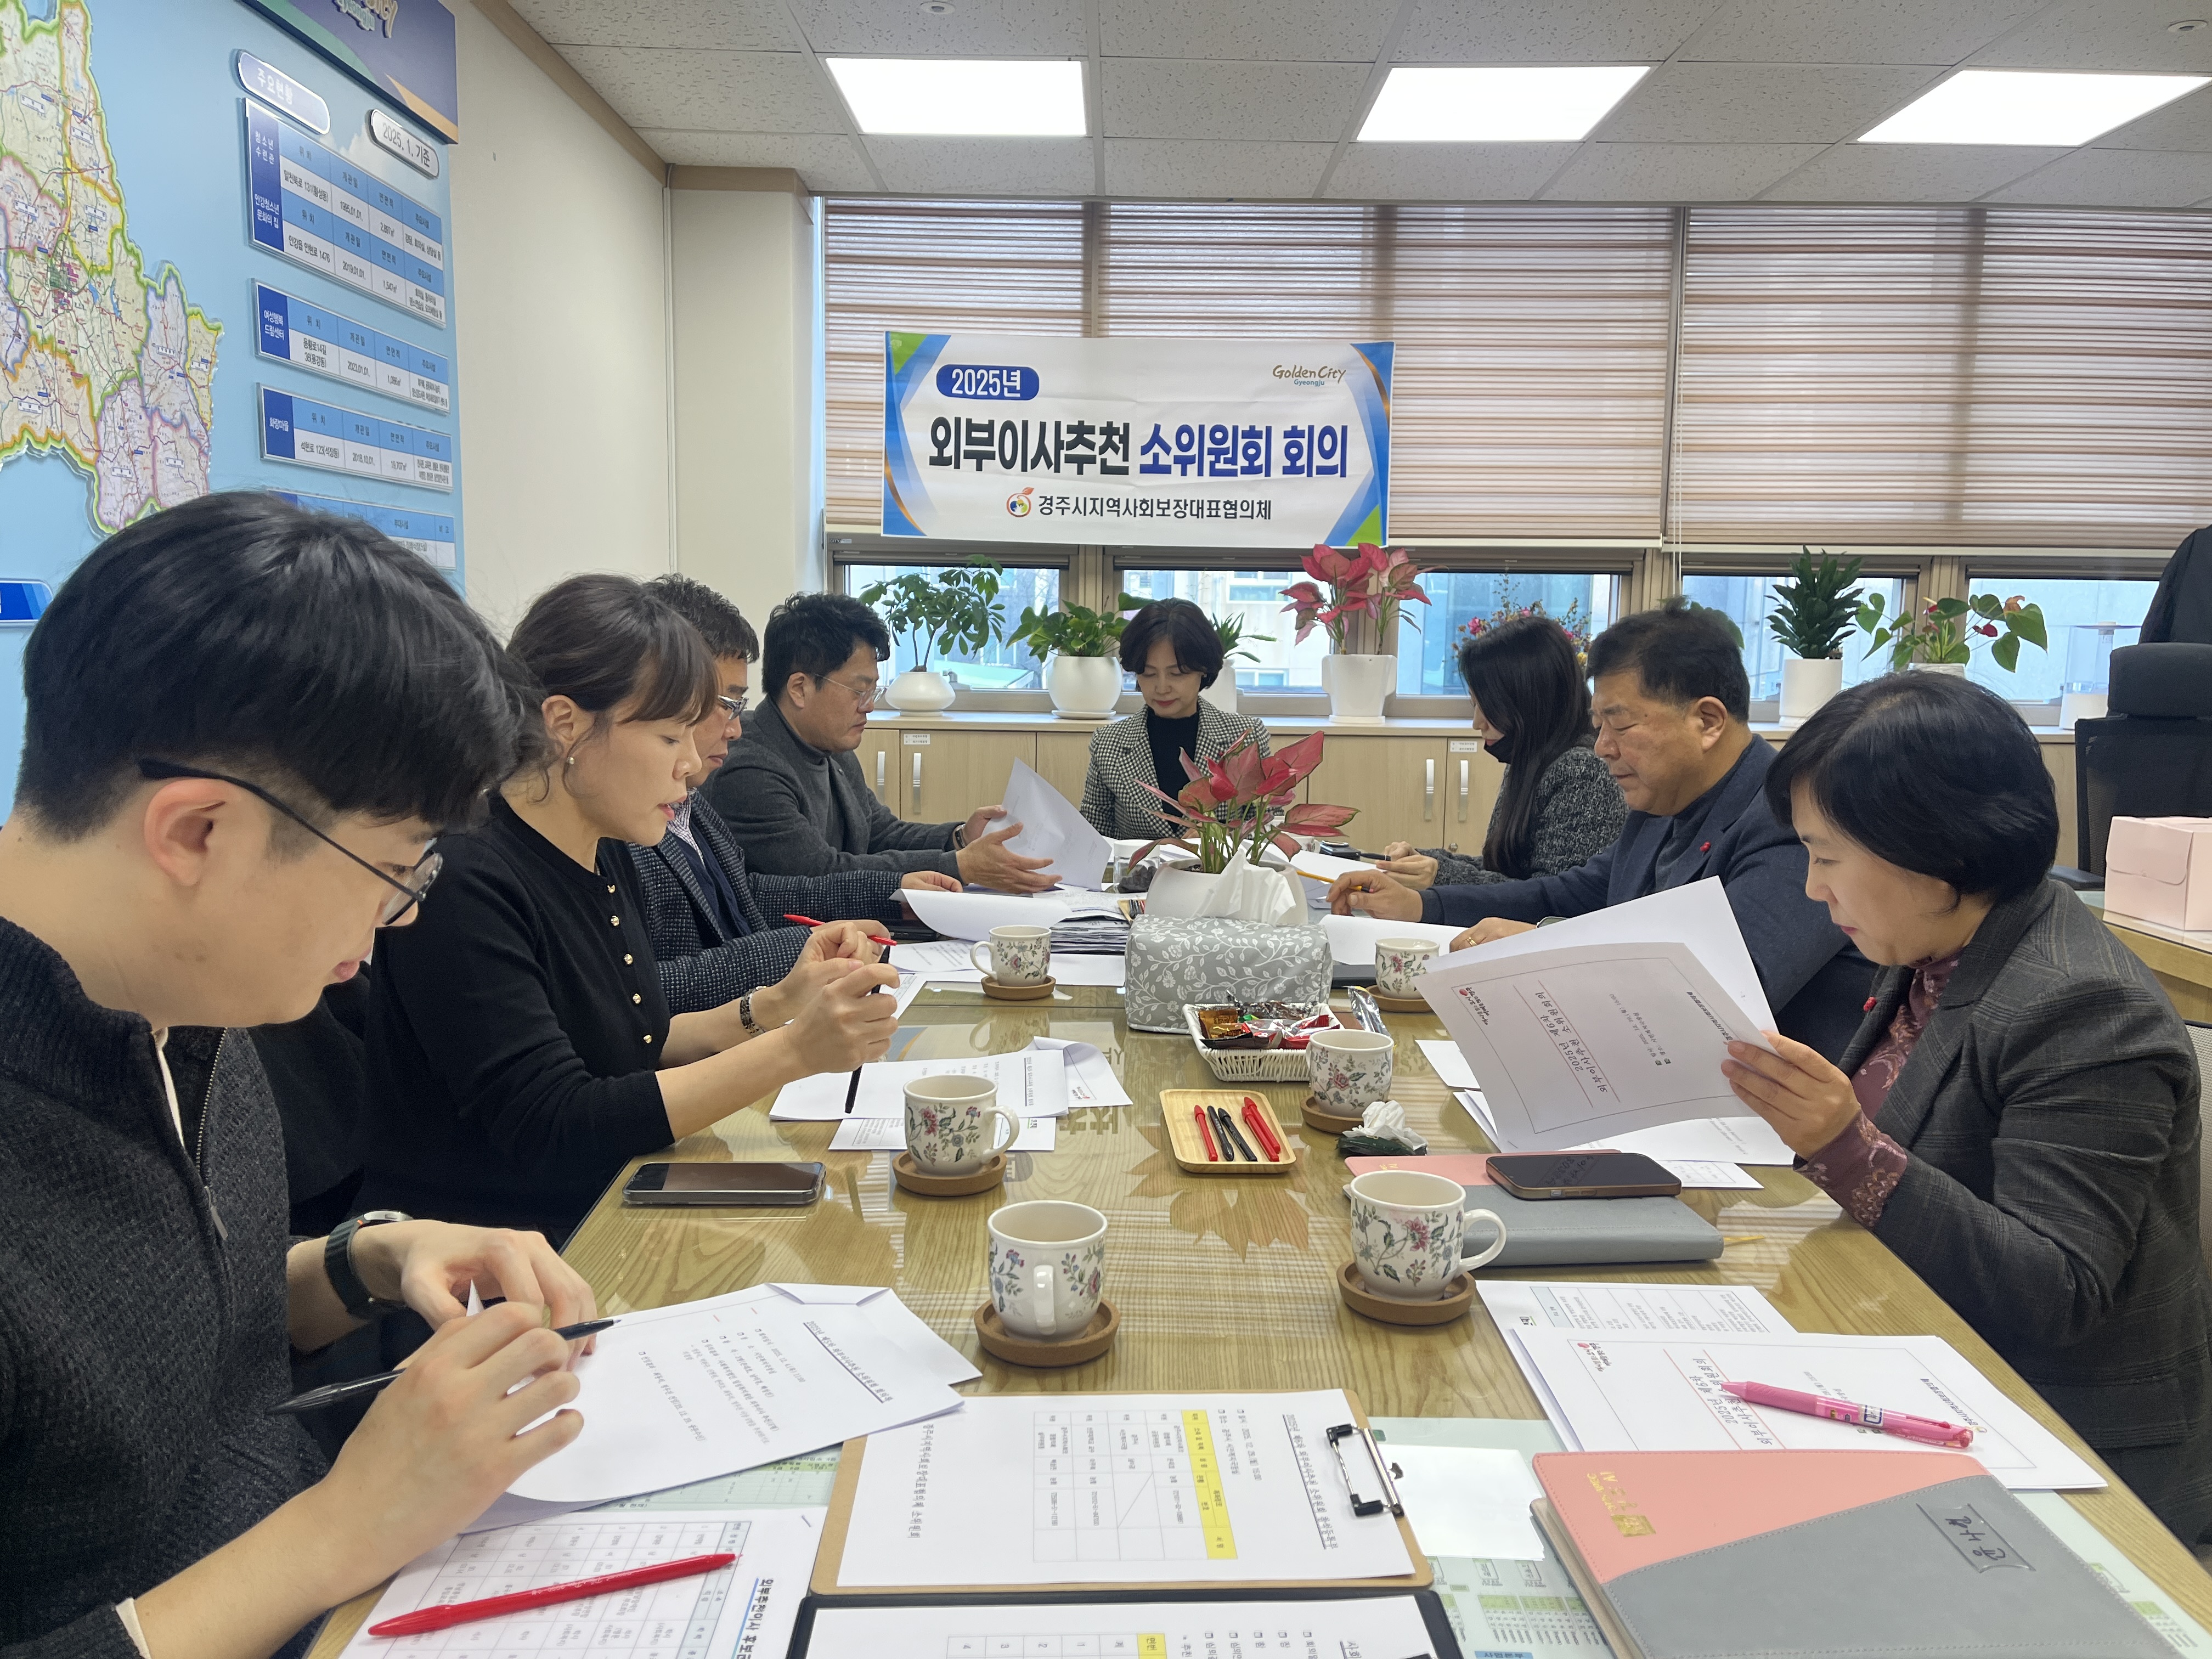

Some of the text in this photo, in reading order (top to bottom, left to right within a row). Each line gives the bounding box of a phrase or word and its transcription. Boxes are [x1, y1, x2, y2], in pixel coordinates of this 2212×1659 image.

[257, 67, 294, 105] 주요현황
[255, 132, 274, 149] 청소년
[383, 122, 404, 151] 2025.
[416, 148, 431, 168] 기준
[256, 147, 275, 165] 수련관
[254, 194, 279, 215] 안강청소년
[263, 310, 283, 325] 여성행복
[264, 324, 284, 340] 드림센터
[951, 368, 1022, 398] 2025년
[1272, 364, 1347, 382] Golden City
[1293, 378, 1325, 387] Gyeongju
[269, 417, 289, 432] 화랑마을
[928, 416, 1348, 478] 외부이사추천 소위원회 회의
[1038, 494, 1273, 521] 경주시지역사회보장대표협의체
[1534, 991, 1608, 1093] 외부이사추천 소위원회의
[1541, 1014, 1584, 1072] 2025년 제6차
[1689, 1375, 1739, 1424] 2025년 제6차
[1724, 1398, 1773, 1446] 외부이사추천
[907, 1424, 934, 1539] 경주시지역사회보장대표협의체 소위원회
[1299, 1451, 1318, 1486] 외부이사추천
[1309, 1489, 1327, 1513] 소위원회
[751, 1578, 774, 1631] 외부추천이사
[1146, 1637, 1158, 1651] 연번
[1182, 1644, 1193, 1657] 추천
[1347, 1641, 1362, 1658] 사회
